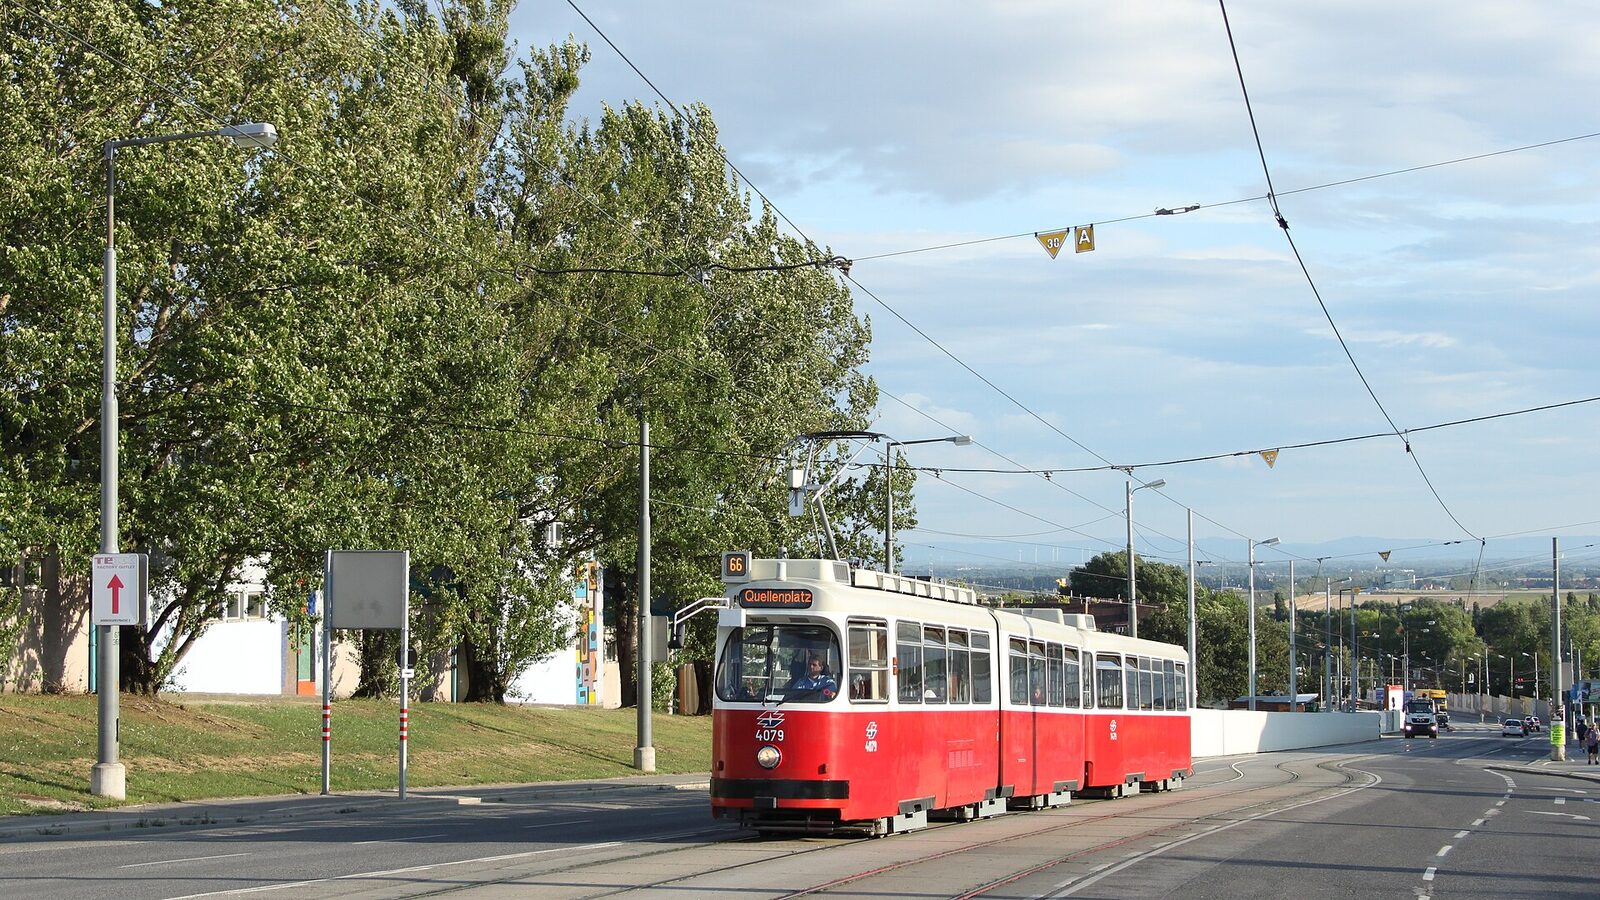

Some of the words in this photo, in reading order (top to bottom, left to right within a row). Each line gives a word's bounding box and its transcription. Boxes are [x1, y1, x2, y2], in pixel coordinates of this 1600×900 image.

[1047, 237, 1060, 249] 30
[1078, 229, 1091, 245] A
[729, 557, 743, 572] 66
[744, 589, 812, 604] Quellenplatz
[755, 729, 785, 741] 4079
